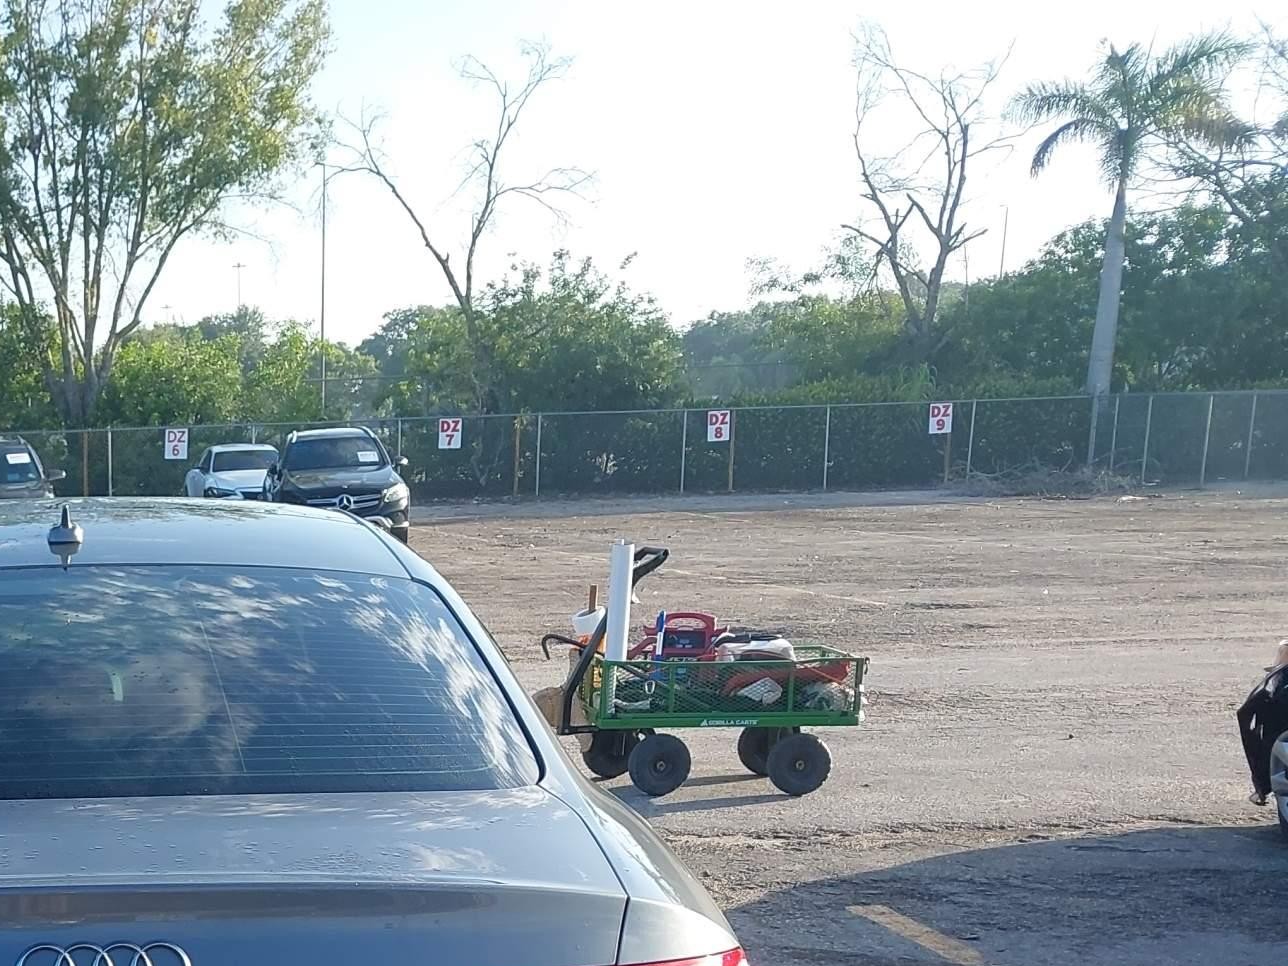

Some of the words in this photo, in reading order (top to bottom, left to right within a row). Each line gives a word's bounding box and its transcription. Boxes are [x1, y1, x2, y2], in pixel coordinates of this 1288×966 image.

[931, 404, 951, 418] DZ
[709, 412, 729, 426] DZ
[936, 419, 945, 431] 9
[440, 420, 460, 433] DZ
[167, 430, 186, 443] DZ
[714, 427, 723, 439] 8
[445, 434, 455, 446] 7
[172, 445, 180, 456] 6
